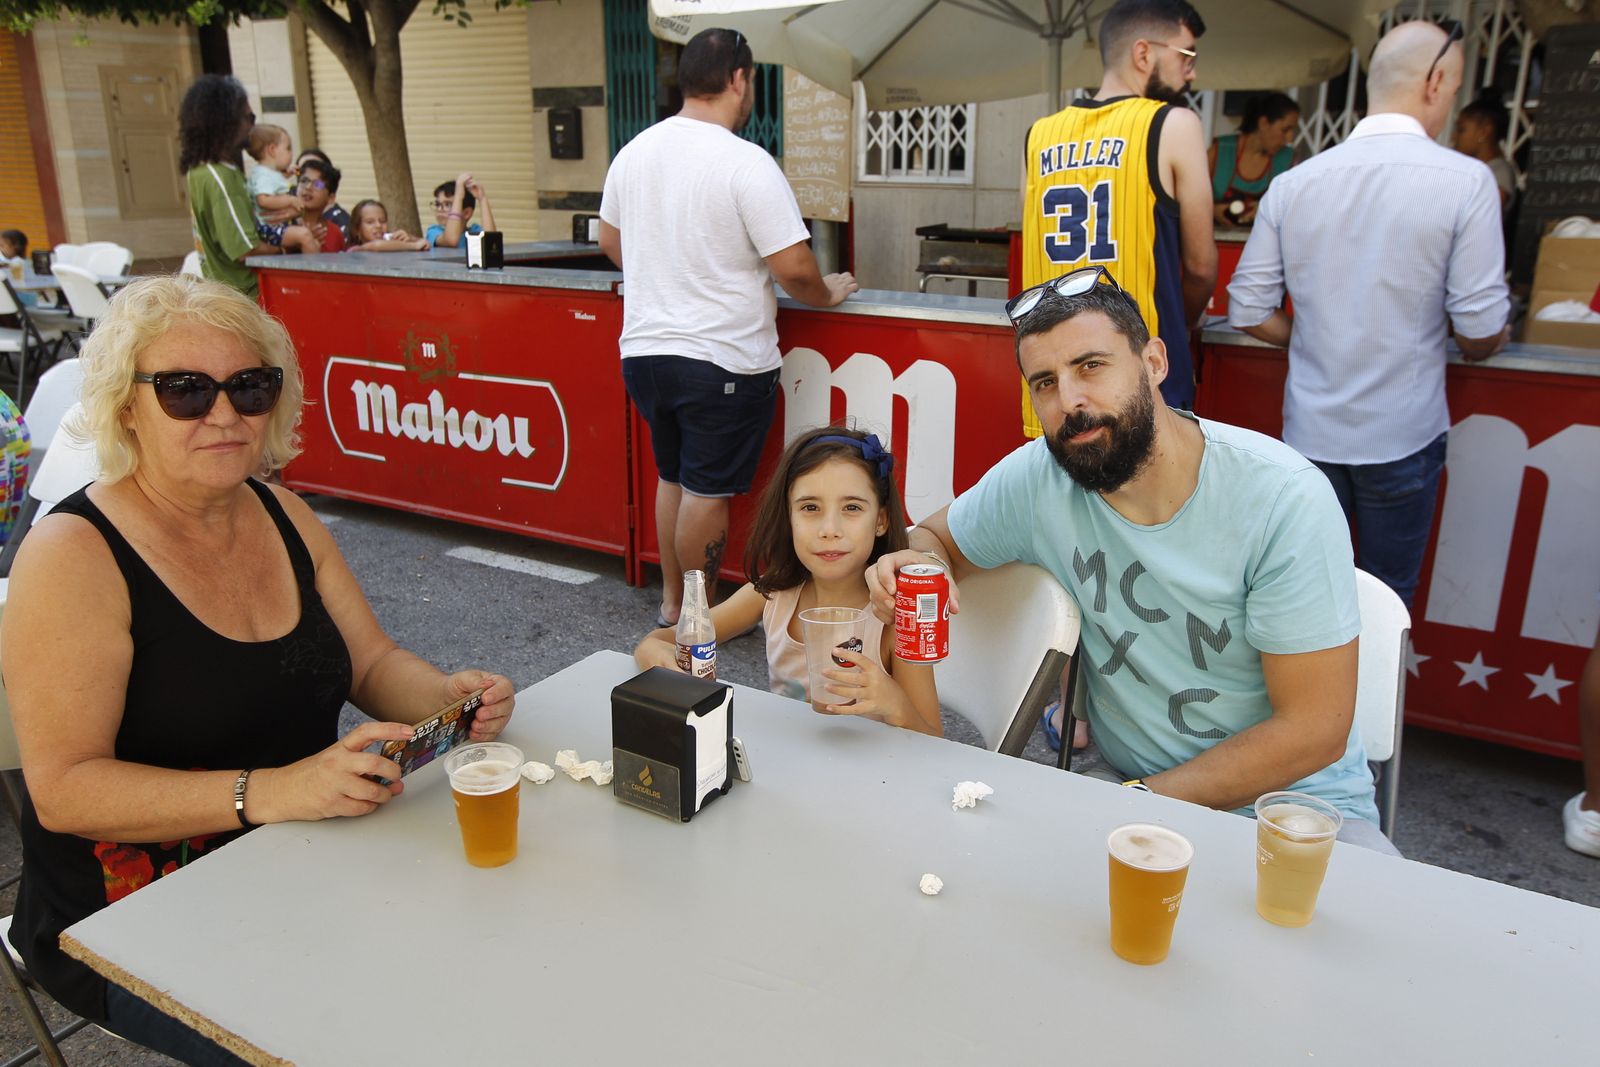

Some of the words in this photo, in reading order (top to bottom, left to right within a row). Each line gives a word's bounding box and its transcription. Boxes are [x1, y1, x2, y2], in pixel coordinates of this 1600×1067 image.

[1040, 138, 1125, 178] MILLER
[1042, 180, 1118, 264] 31
[351, 379, 536, 459] Mahou
[1094, 622, 1149, 686] X
[1168, 688, 1229, 739] C
